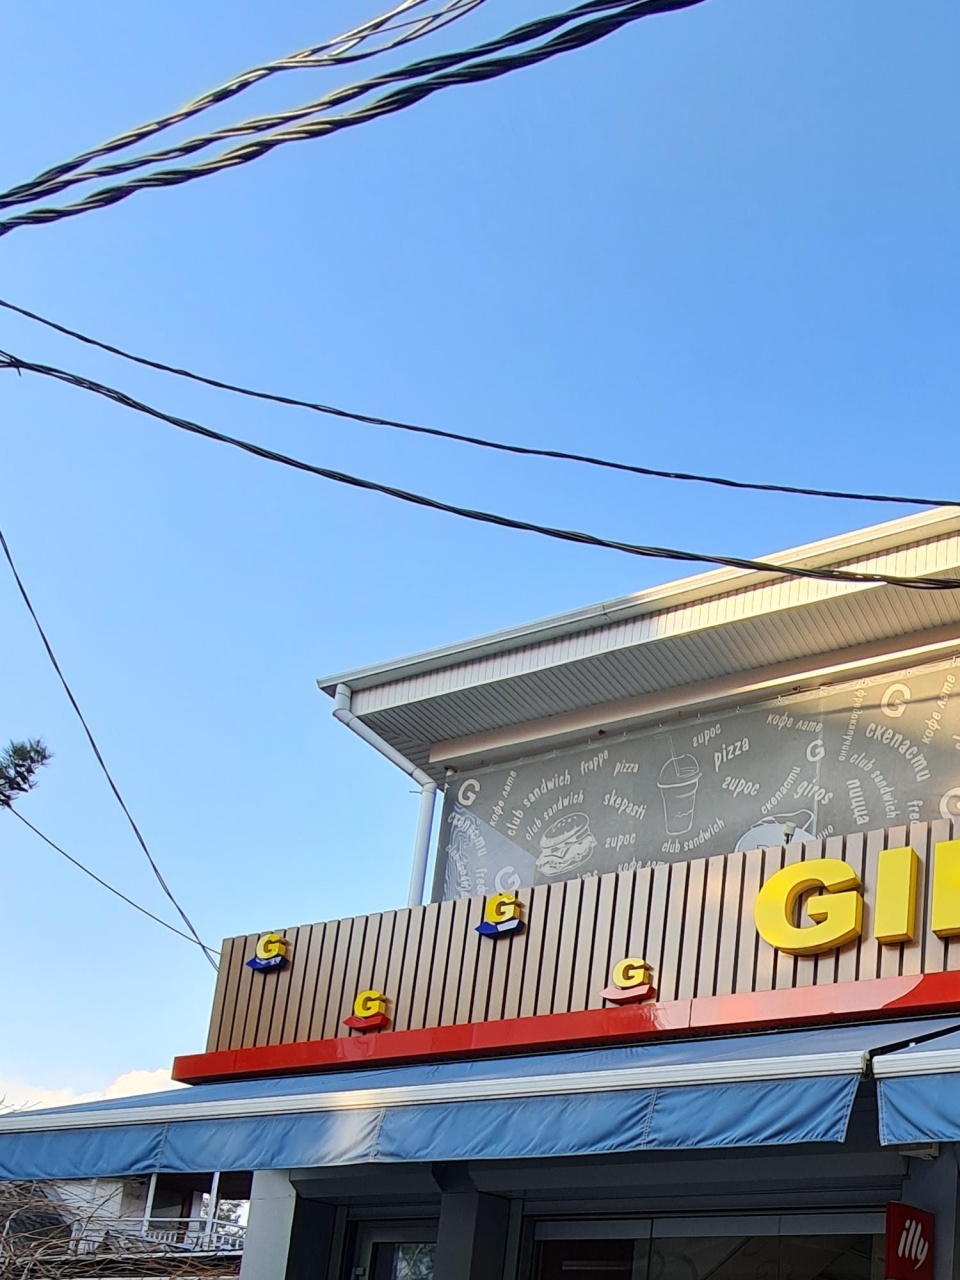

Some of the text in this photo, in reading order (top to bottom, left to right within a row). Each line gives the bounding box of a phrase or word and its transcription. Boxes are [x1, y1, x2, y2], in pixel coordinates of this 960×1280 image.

[881, 683, 911, 717] G
[692, 724, 721, 747] гирос
[766, 711, 823, 733] кофе лате
[921, 711, 942, 744] кофе
[580, 750, 609, 775] frappe
[714, 737, 750, 772] pizza
[806, 739, 825, 762] G
[866, 722, 931, 782] скепасти
[613, 759, 639, 776] pizza
[458, 778, 481, 806] G
[722, 776, 760, 798] гирос
[760, 766, 801, 814] скепасти
[793, 779, 833, 804] giros
[850, 752, 901, 819] club sandwich
[489, 799, 505, 827] кофе
[507, 769, 571, 836] club sandwich
[525, 789, 584, 841] club sandwich
[603, 790, 647, 820] skepasti
[846, 778, 869, 825] пицца
[605, 832, 636, 851] гирос
[661, 817, 725, 854] club sandwich
[485, 893, 522, 924] G
[256, 933, 288, 961] G
[612, 957, 652, 989] G
[353, 989, 388, 1018] G
[898, 1219, 929, 1270] illy
